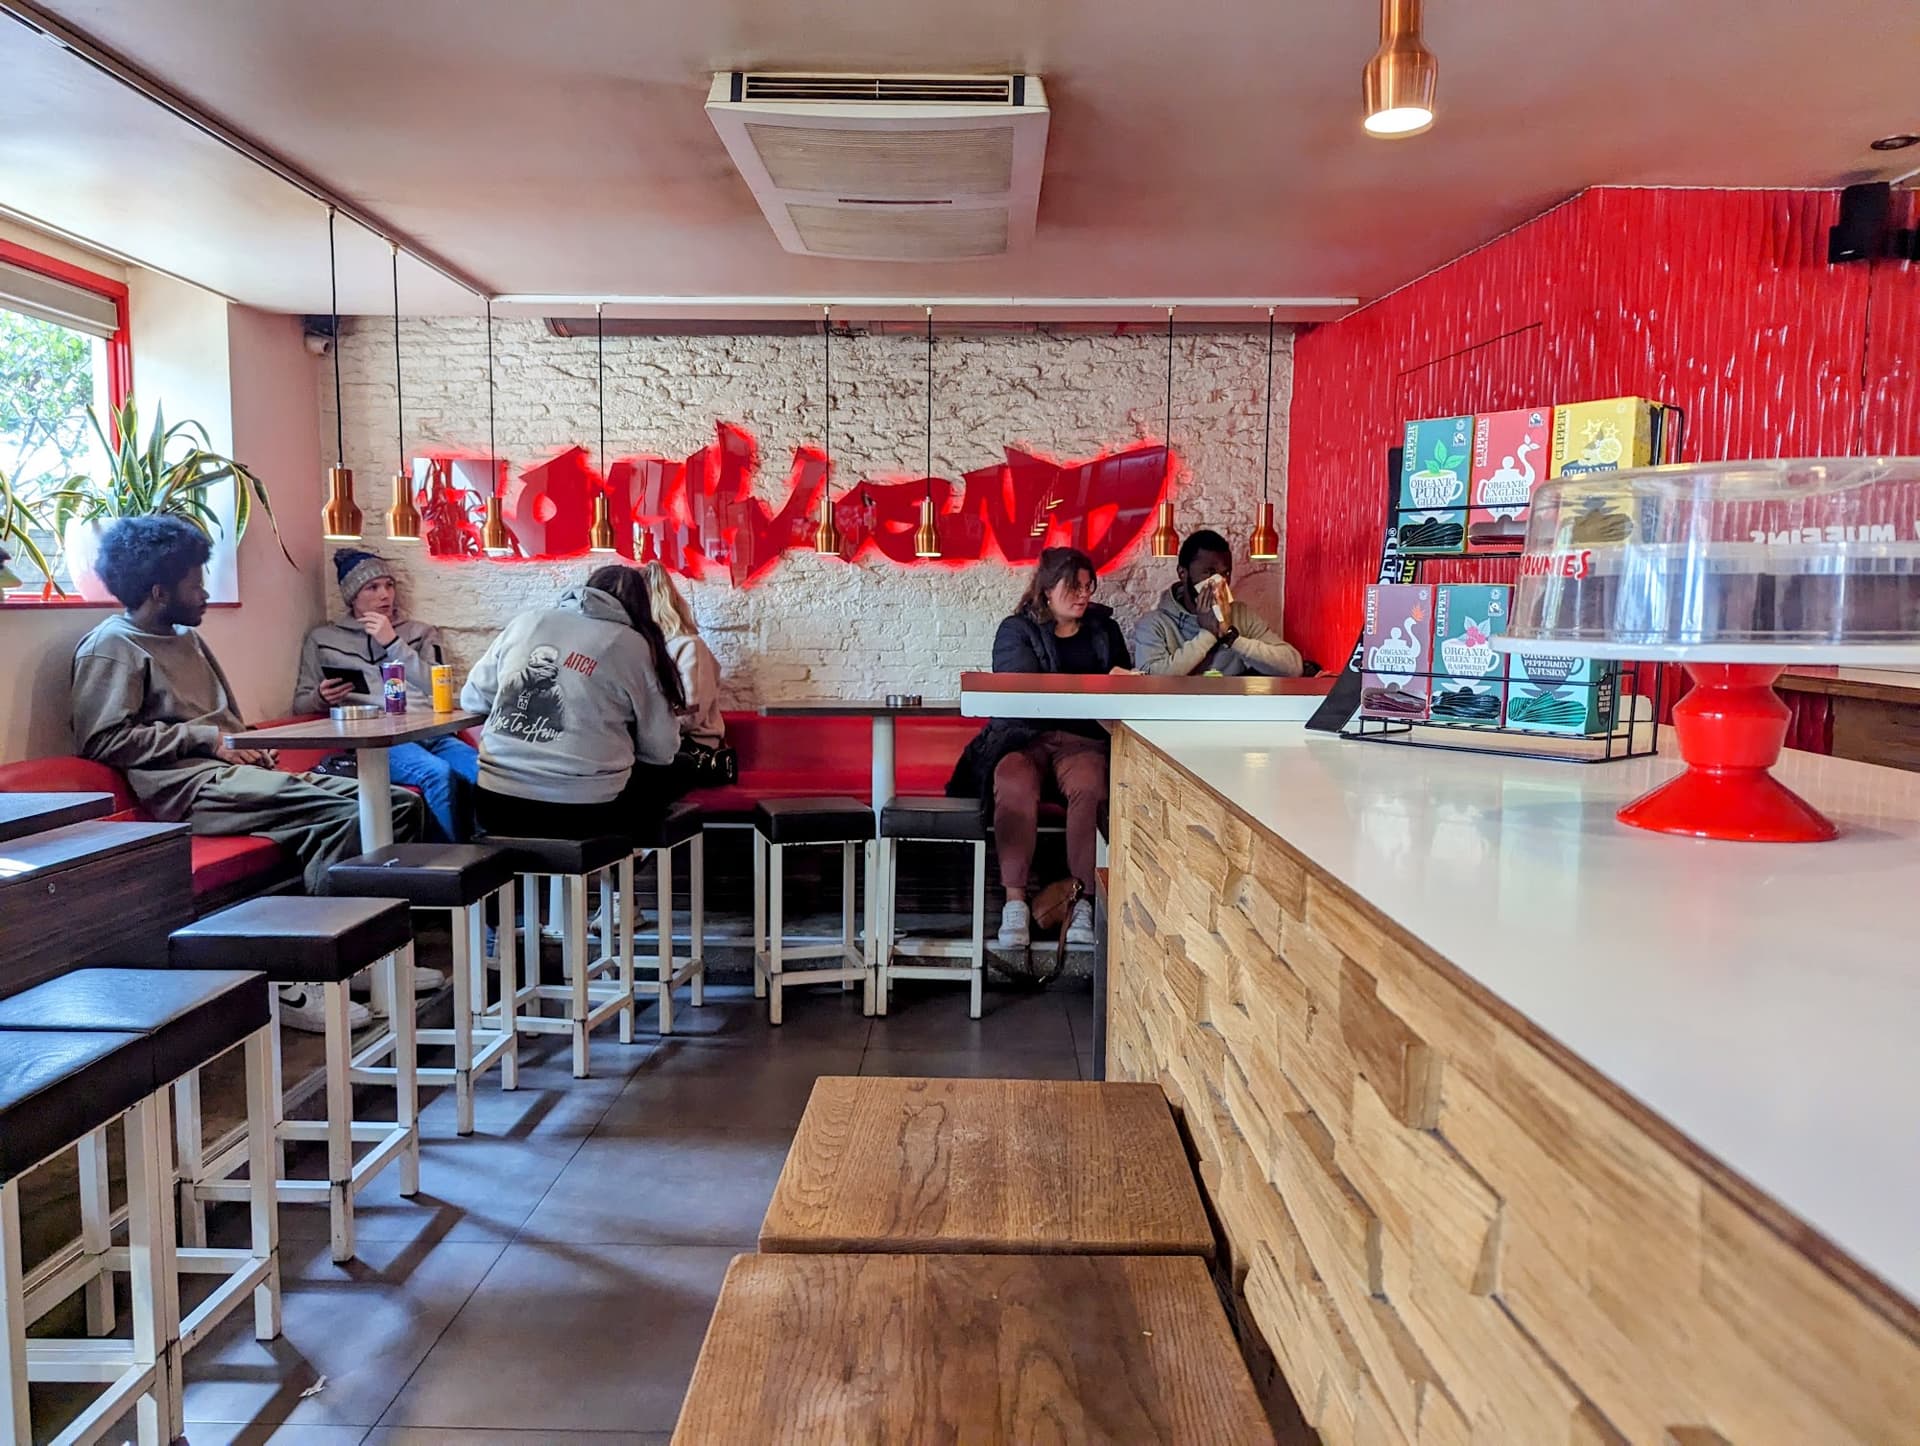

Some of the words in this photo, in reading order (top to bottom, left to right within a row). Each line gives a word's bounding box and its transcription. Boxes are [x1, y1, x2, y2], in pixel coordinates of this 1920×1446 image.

[1556, 409, 1567, 460] CLIPPER
[1405, 424, 1415, 471] CLIPPER
[1476, 418, 1486, 467] CLIPPER
[1411, 478, 1455, 489] ORGANIC
[1487, 480, 1527, 489] ORGANIC
[1415, 487, 1452, 499] PURE
[1486, 487, 1529, 498] ENGLISH
[1367, 588, 1376, 635] CLIPPER
[1436, 588, 1447, 637] CLIPPER
[1380, 648, 1410, 656] ORGANIC
[1444, 646, 1490, 657] ORGANIC
[563, 651, 598, 677] AITCH
[1376, 655, 1415, 665] ROOIBOS
[1444, 655, 1472, 663] GREEN
[1473, 657, 1489, 665] TEA
[1523, 660, 1573, 669] PEPPERMINT
[1528, 668, 1567, 677] INFUSION
